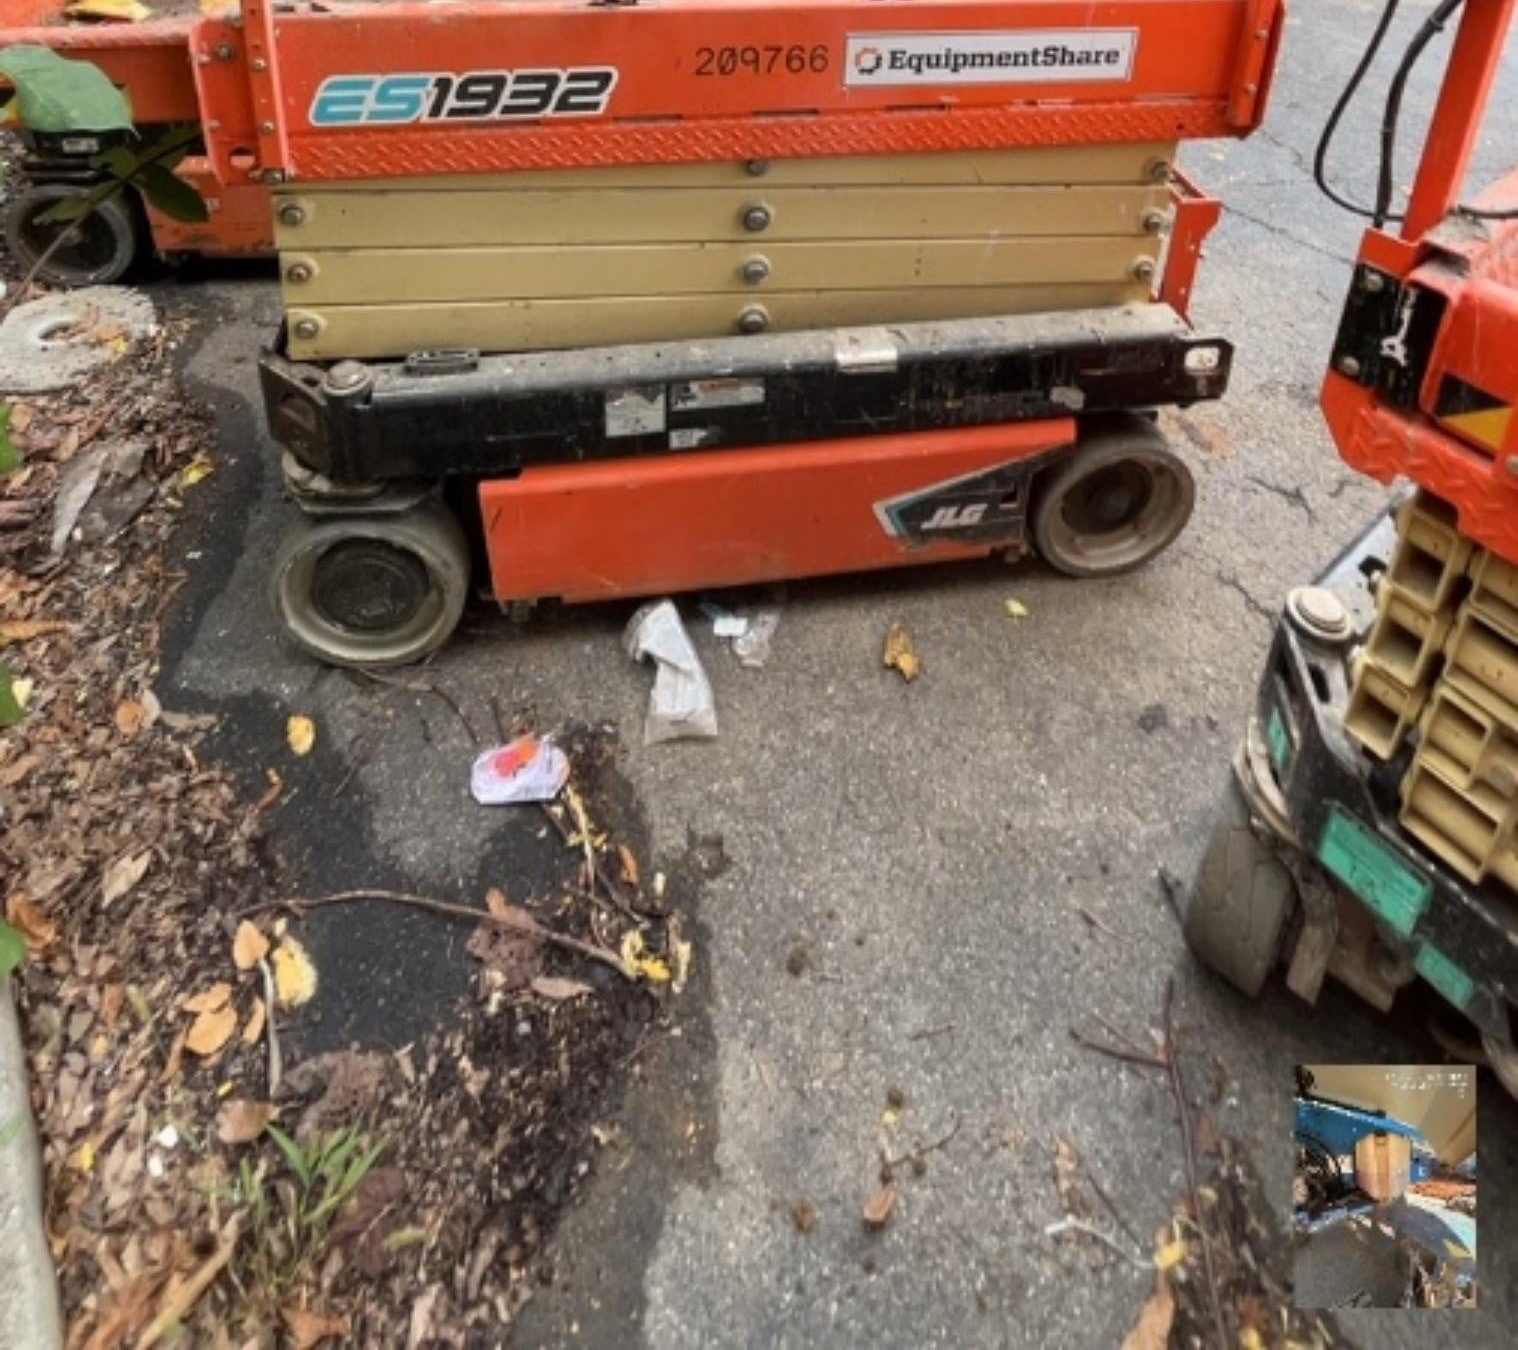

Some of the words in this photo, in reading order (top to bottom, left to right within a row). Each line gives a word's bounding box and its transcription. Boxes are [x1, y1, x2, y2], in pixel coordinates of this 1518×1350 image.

[694, 45, 829, 77] 209766
[887, 46, 1121, 74] EquipmentShare
[311, 68, 616, 125] ES1932
[920, 503, 989, 530] JLG
